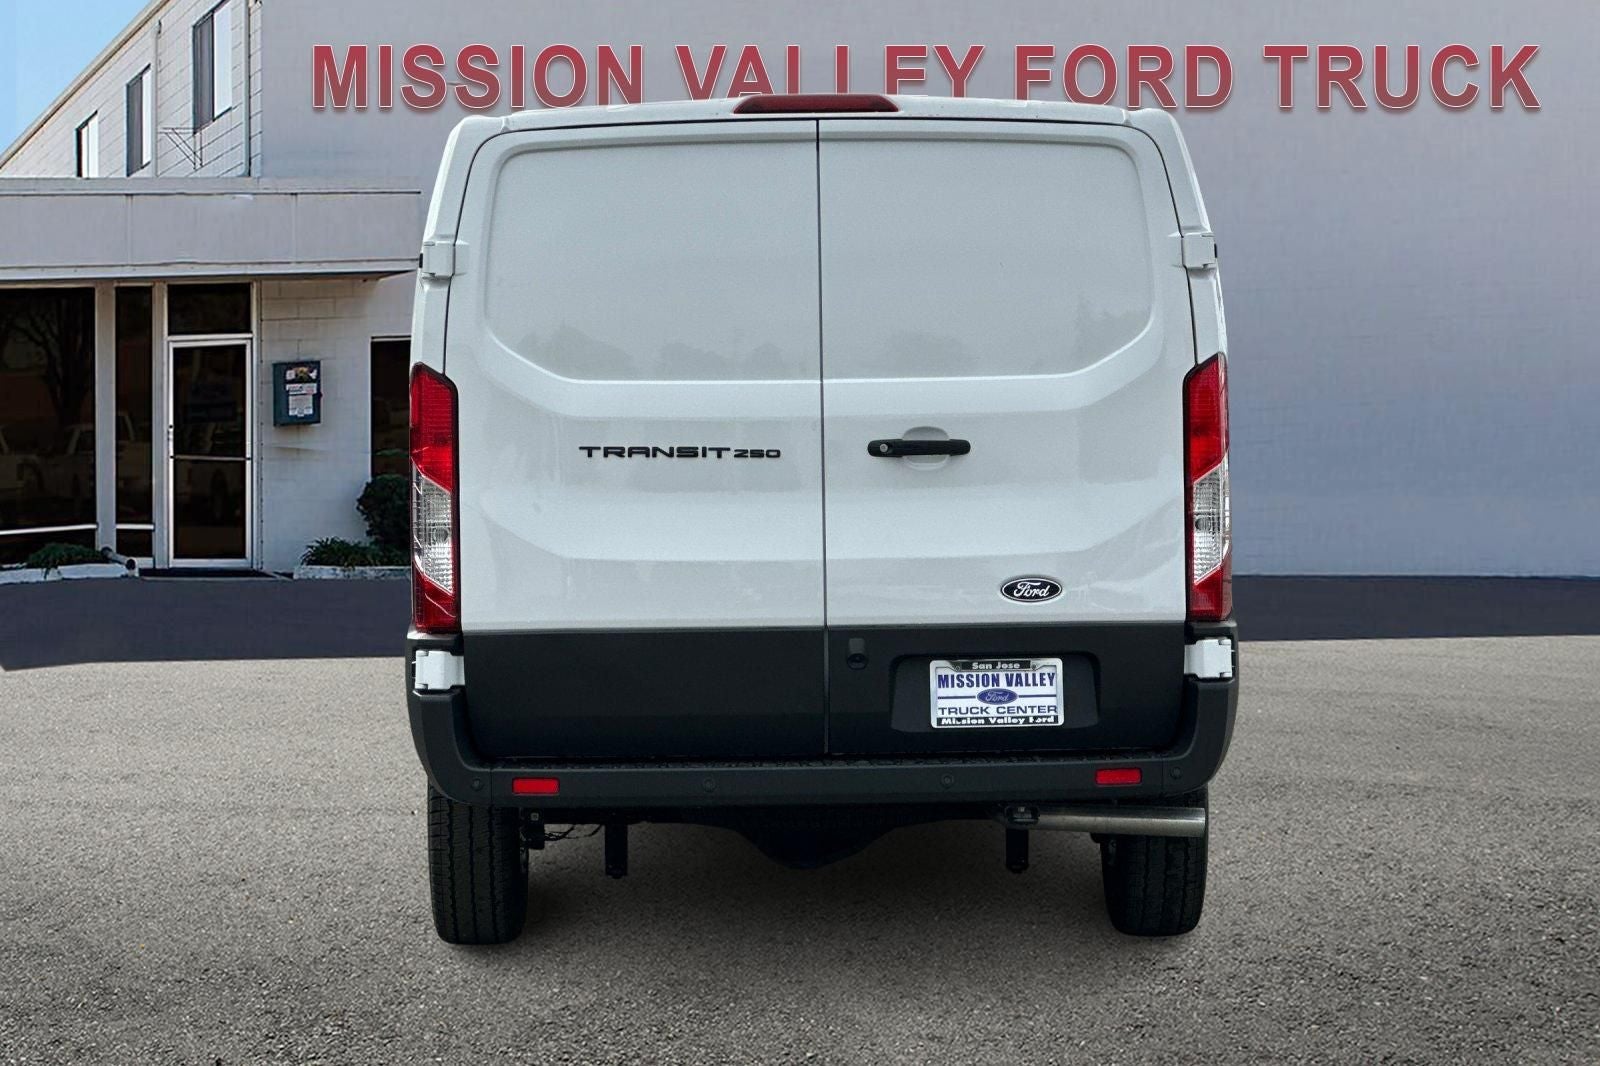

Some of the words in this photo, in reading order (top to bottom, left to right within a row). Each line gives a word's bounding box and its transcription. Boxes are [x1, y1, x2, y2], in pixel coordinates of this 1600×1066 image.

[312, 44, 643, 108] MISSION
[1014, 44, 1233, 109] FORD
[1263, 44, 1542, 109] TRUCK
[578, 446, 731, 459] TRANSIT
[733, 448, 781, 459] 250
[1013, 581, 1050, 598] Ford
[972, 662, 993, 670] San
[996, 661, 1021, 670] Jose
[937, 673, 1001, 689] MISSION
[1004, 672, 1056, 688] VALLEY
[938, 706, 990, 716] TRUCK
[996, 705, 1058, 715] CENTER
[988, 716, 1026, 726] Valley
